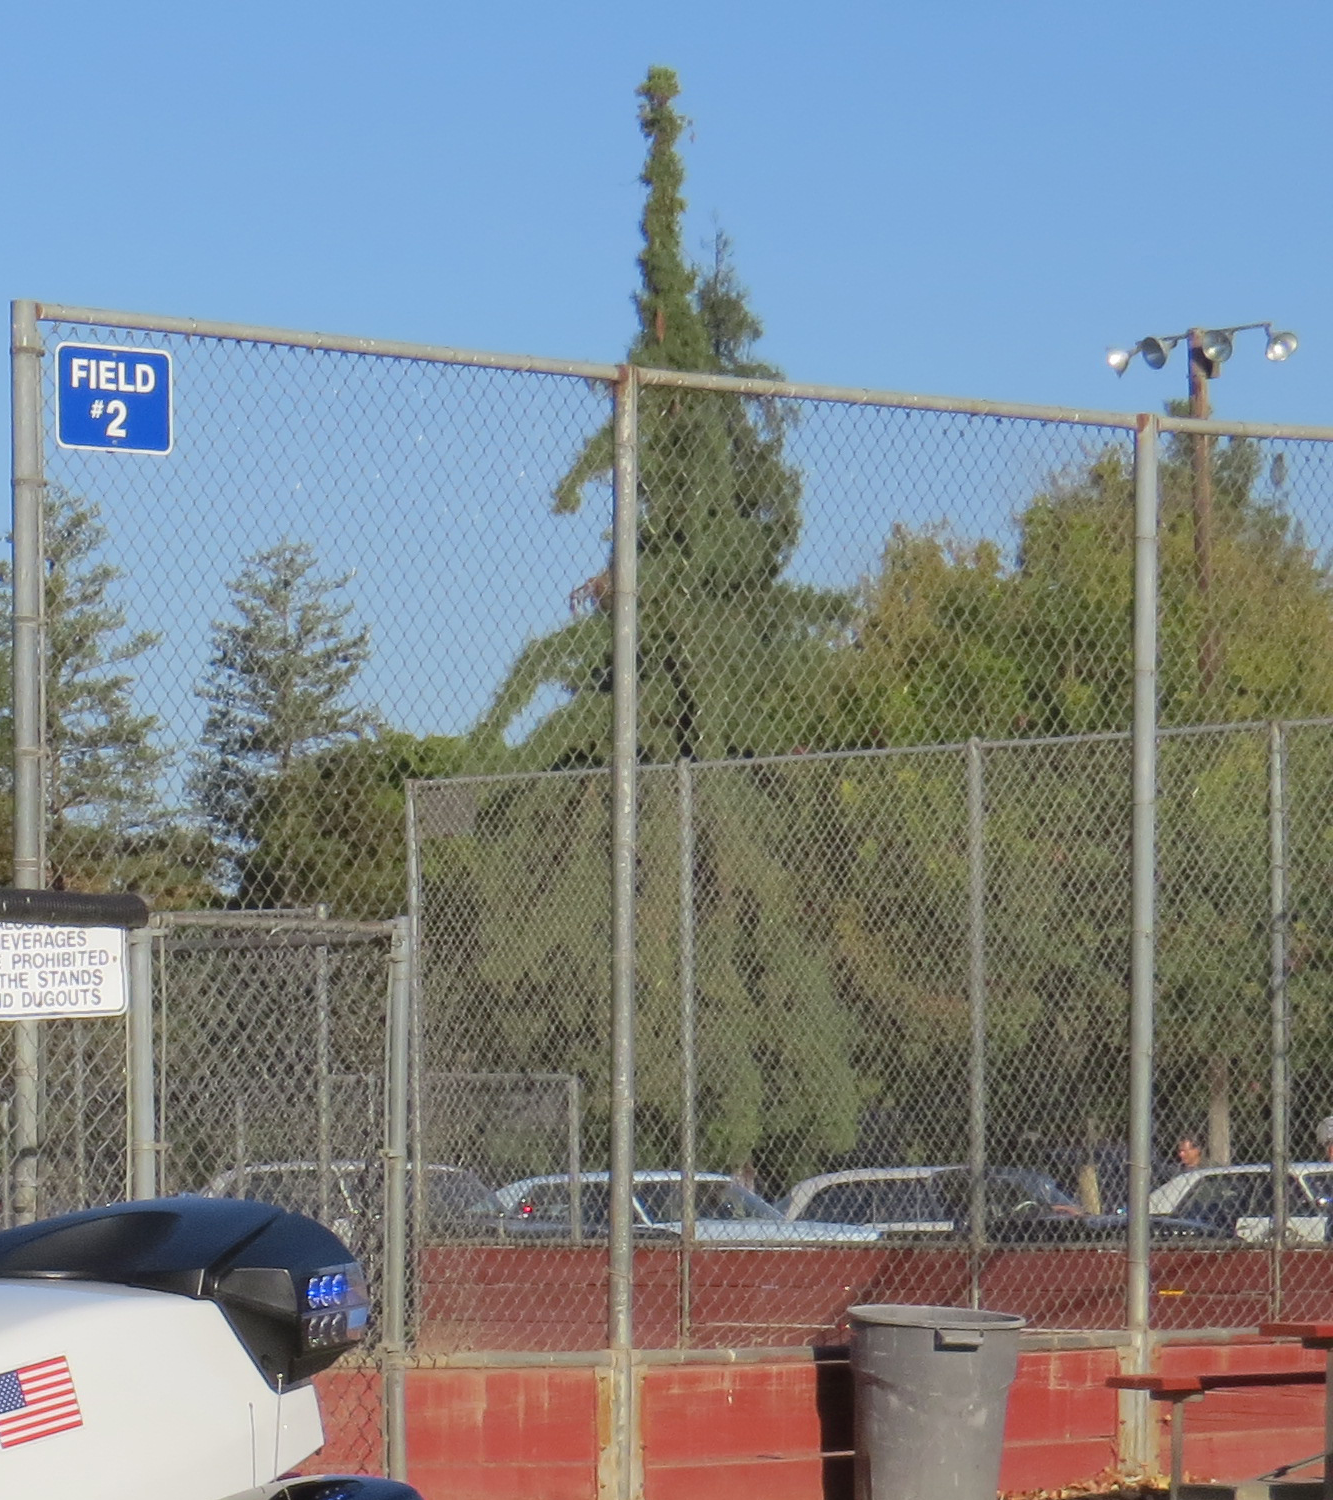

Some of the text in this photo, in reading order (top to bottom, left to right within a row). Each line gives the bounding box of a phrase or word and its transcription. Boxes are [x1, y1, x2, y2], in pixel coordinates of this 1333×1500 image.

[70, 358, 155, 393] FIELD
[90, 399, 128, 438] #2
[12, 949, 110, 970] PROHIBITED
[37, 969, 104, 989] STANDS
[22, 988, 102, 1009] DUGOUTS
